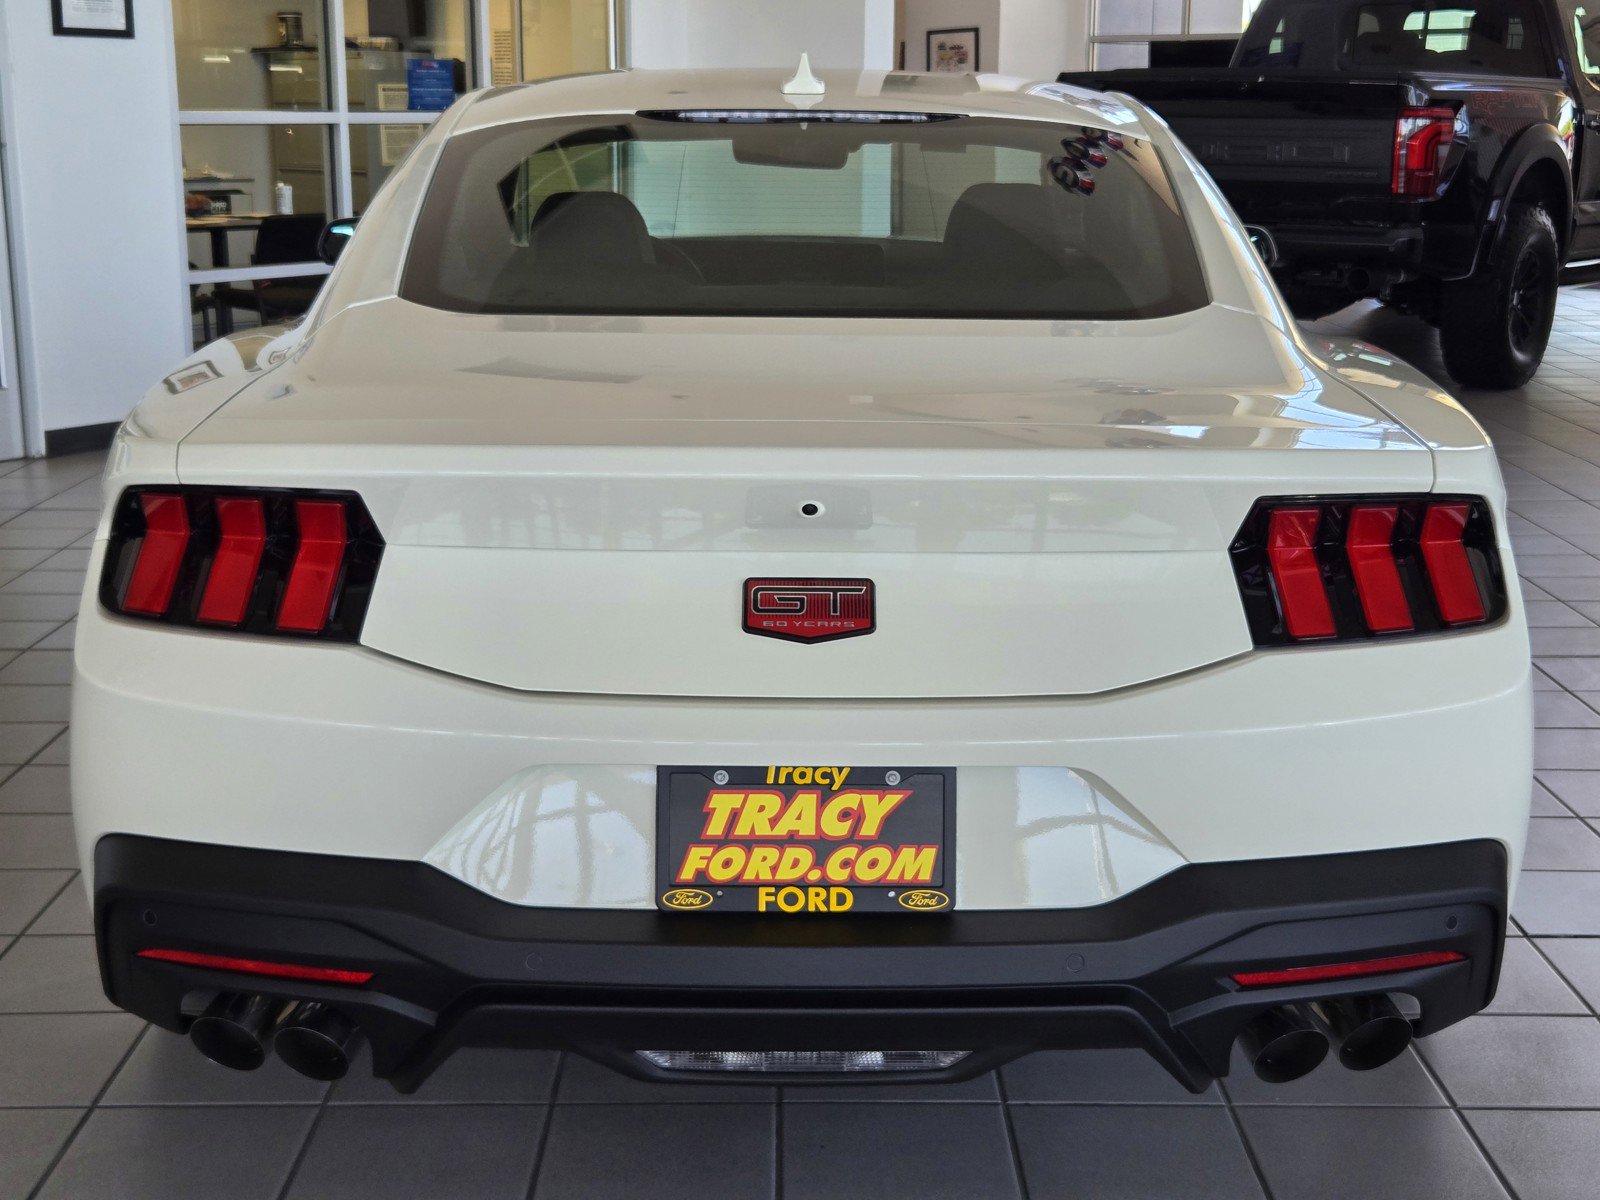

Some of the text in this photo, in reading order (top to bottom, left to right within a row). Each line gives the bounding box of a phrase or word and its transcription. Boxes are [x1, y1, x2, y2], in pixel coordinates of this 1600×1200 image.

[751, 585, 867, 615] GT
[762, 620, 855, 628] 60 YEARS
[701, 790, 914, 841] TRACY
[675, 844, 939, 884] FORD.COM
[671, 890, 705, 907] Ford
[757, 886, 854, 913] FORD
[907, 891, 940, 908] Ford
